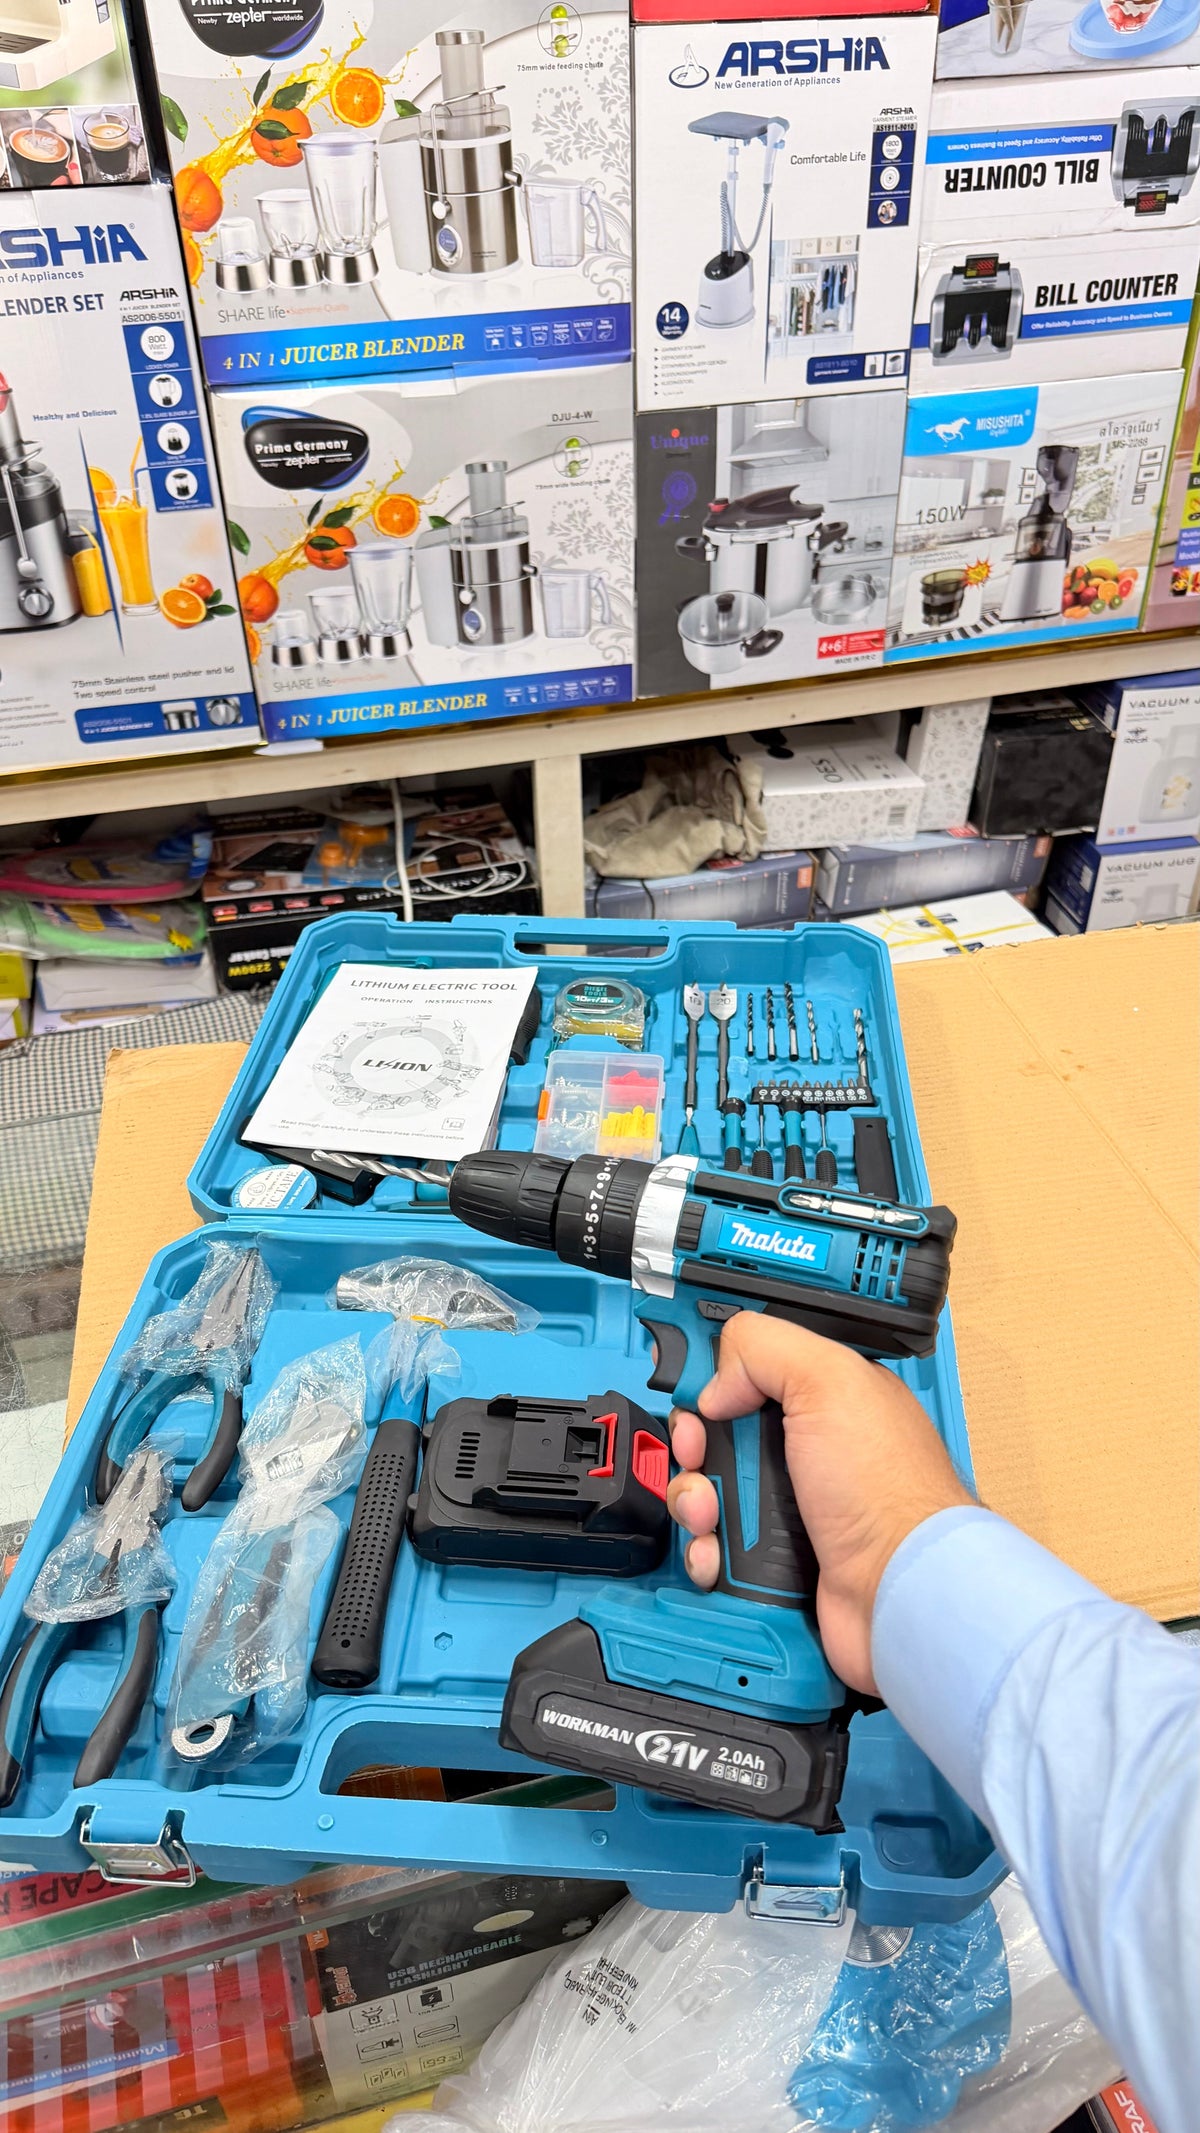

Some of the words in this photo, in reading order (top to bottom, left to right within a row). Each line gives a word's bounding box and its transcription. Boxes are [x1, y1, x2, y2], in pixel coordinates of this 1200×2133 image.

[222, 7, 271, 27] zepter
[517, 64, 538, 72] 75mm
[557, 62, 583, 70] feeding
[584, 61, 604, 69] chute
[714, 81, 732, 89] New
[734, 78, 782, 89] Generation
[784, 77, 792, 86] of
[794, 76, 841, 87] Appliances
[1034, 137, 1059, 145] Accuracy
[790, 153, 847, 165] Comfortable
[850, 151, 866, 162] Life
[945, 162, 1047, 193] COUNTER
[1054, 159, 1099, 185] BILL
[8, 273, 19, 283] of
[21, 270, 84, 284] Appliances
[1035, 283, 1078, 308] BILL
[1086, 273, 1179, 303] COUNTER
[73, 293, 104, 312] SET
[217, 307, 265, 323] SHARE
[268, 306, 286, 320] life
[661, 307, 681, 323] 14
[1072, 318, 1096, 326] Accuracy
[1107, 315, 1123, 323] Speed
[1130, 312, 1152, 320] Business
[148, 335, 166, 343] 800
[223, 356, 233, 369] 4
[239, 352, 261, 369] IN
[269, 353, 274, 366] 1
[281, 342, 358, 365] JUICER
[363, 333, 465, 358] BLENDER
[33, 414, 63, 422] Healthy
[82, 409, 117, 418] Delicious
[552, 411, 593, 422] DJU-4-W
[976, 414, 1024, 431] MISUSHITA
[254, 443, 291, 454] Prima
[294, 440, 348, 452] Germany
[650, 433, 709, 450] Unique
[283, 453, 324, 469] zepter
[916, 505, 967, 525] 150W
[819, 639, 842, 654] 4+6
[72, 681, 102, 689] 75mm
[104, 676, 146, 685] Stainless
[148, 673, 169, 681] steel
[173, 670, 202, 680] pusher
[206, 667, 222, 676] and
[225, 666, 234, 674] lid
[272, 678, 314, 693] SHARE
[317, 676, 332, 688] life
[73, 691, 93, 699] Two
[95, 688, 122, 698] speed
[125, 685, 156, 694] control
[1129, 697, 1189, 709] VACUUM
[278, 719, 287, 730] 4
[291, 714, 310, 729] IN
[317, 715, 322, 726] 1
[327, 703, 395, 724] JUICER
[399, 693, 488, 716] BLENDER
[1106, 861, 1163, 872] VACUUM
[1168, 857, 1197, 867] JUG
[228, 962, 272, 977] 2200W
[351, 979, 409, 990] LITHIUM
[482, 983, 518, 991] TOOL
[360, 996, 413, 1004] OPERATION
[298, 1120, 320, 1128] through
[321, 1124, 346, 1132] carefully
[596, 1172, 611, 1181] 9
[589, 1190, 604, 1200] 7
[585, 1212, 599, 1224] 5
[583, 1235, 597, 1245] 3
[583, 1252, 597, 1260] 1
[542, 1709, 634, 1745] WORKMAN
[648, 1735, 709, 1771] 21V
[718, 1747, 765, 1771] 2.0Ah
[387, 1966, 416, 1980] USB
[419, 1934, 522, 1971] RECHARGEABLE
[389, 1959, 470, 1989] FLASHLIGHT
[51, 2043, 165, 2078] Multifunctional
